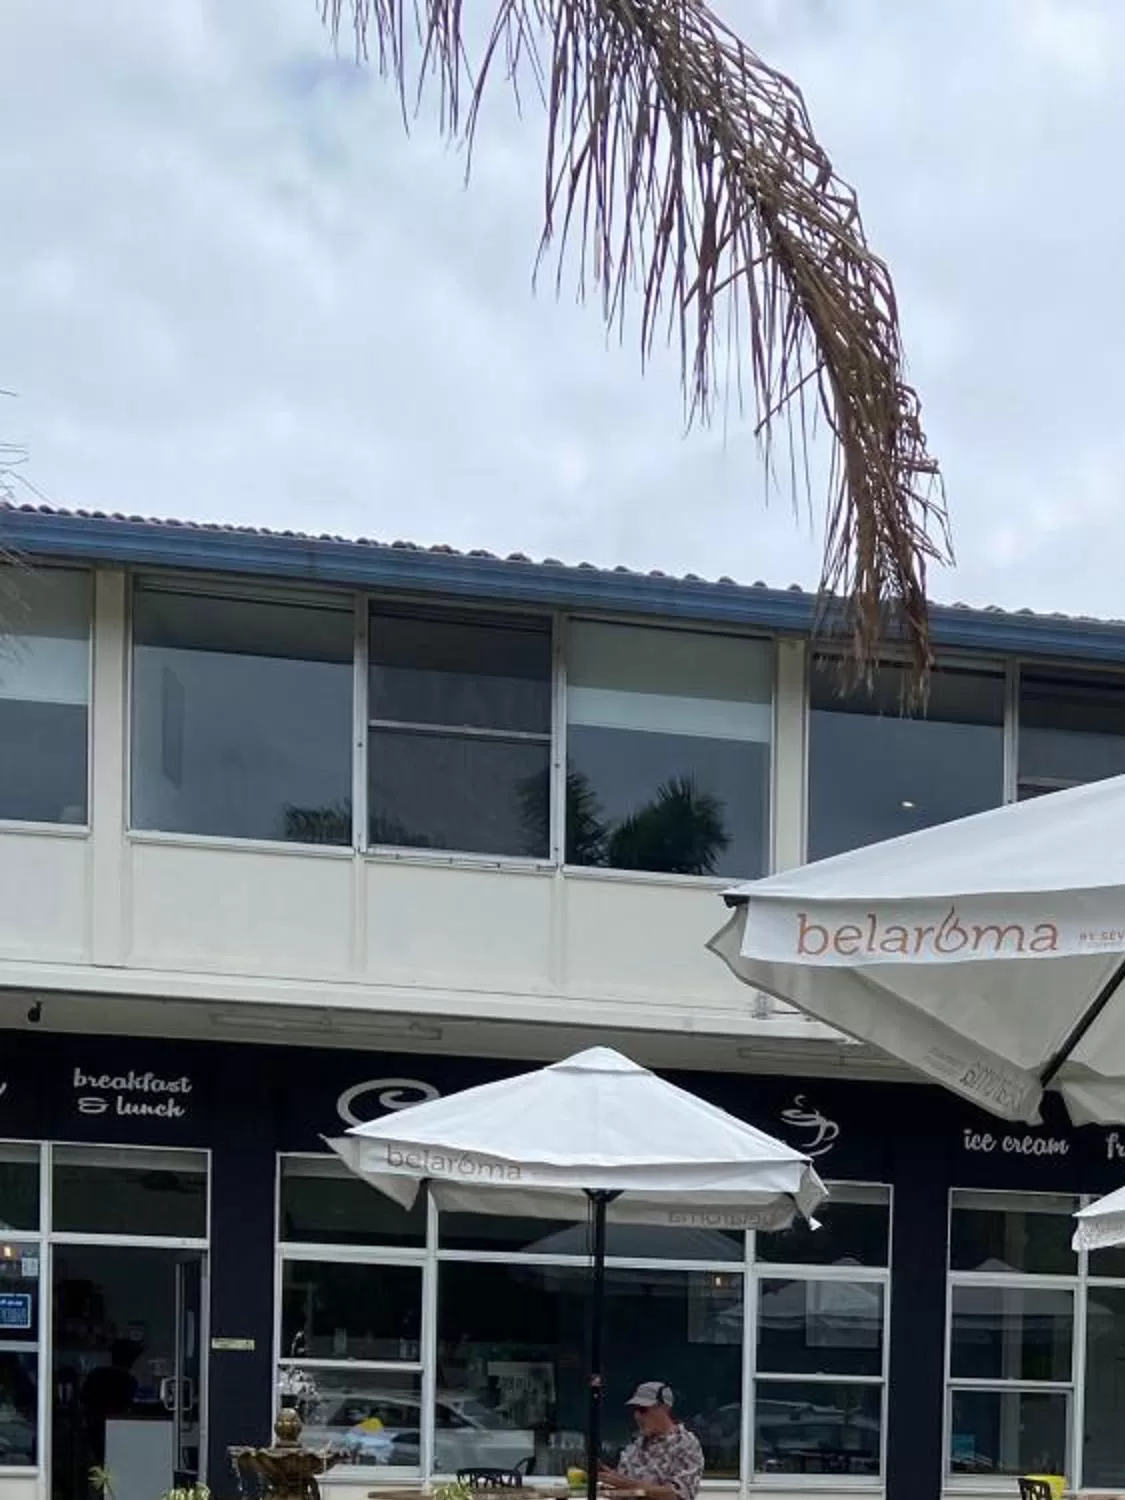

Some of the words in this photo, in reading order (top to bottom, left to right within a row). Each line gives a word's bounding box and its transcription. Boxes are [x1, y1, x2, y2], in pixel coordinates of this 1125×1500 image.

[797, 904, 1060, 955] belaroma
[73, 1067, 192, 1092] breakfast
[116, 1095, 185, 1117] lunch
[963, 1129, 997, 1151] ice
[1002, 1135, 1069, 1155] cream
[387, 1144, 521, 1180] belaroma
